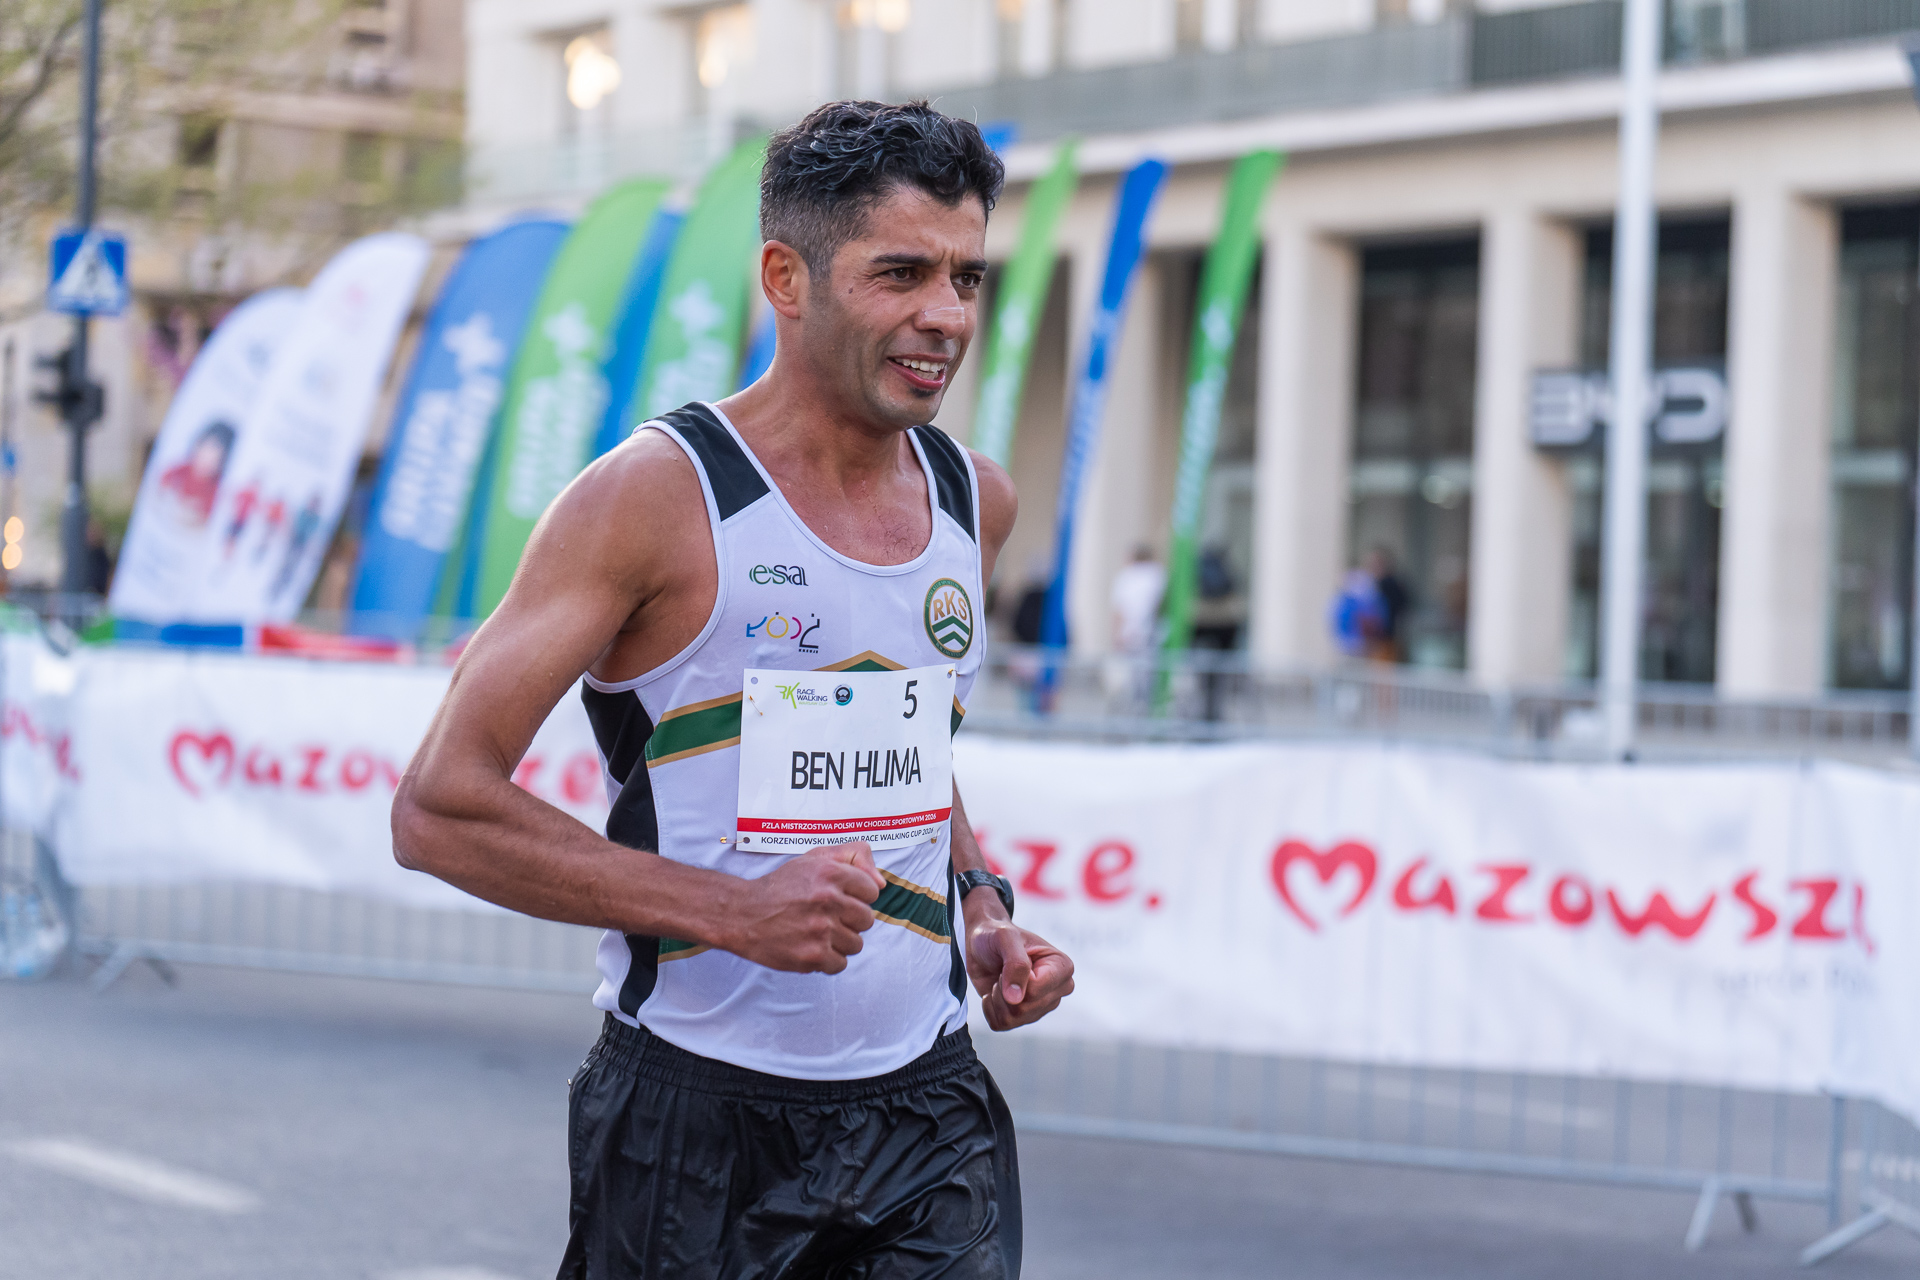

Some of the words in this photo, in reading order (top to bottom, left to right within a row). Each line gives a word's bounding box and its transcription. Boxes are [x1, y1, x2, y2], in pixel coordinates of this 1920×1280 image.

[932, 590, 968, 622] RKS
[796, 688, 816, 696] RACE
[796, 694, 828, 702] WALKING
[902, 679, 918, 720] 5
[790, 750, 845, 791] BEN
[853, 745, 922, 789] HLIMA
[761, 821, 780, 830] PZLA
[780, 822, 833, 831] MISTRZOSTWA
[833, 821, 855, 830] POLSKI
[863, 819, 891, 828] CHODZIE
[891, 814, 925, 827] SPORTOWYM
[924, 812, 937, 821] 2026
[761, 836, 825, 846] KORZENIOWSKI
[826, 834, 860, 845] WARSAW
[860, 834, 879, 842] RACE
[879, 831, 910, 841] WALKING
[910, 828, 922, 838] CUP
[921, 826, 934, 836] 2026
